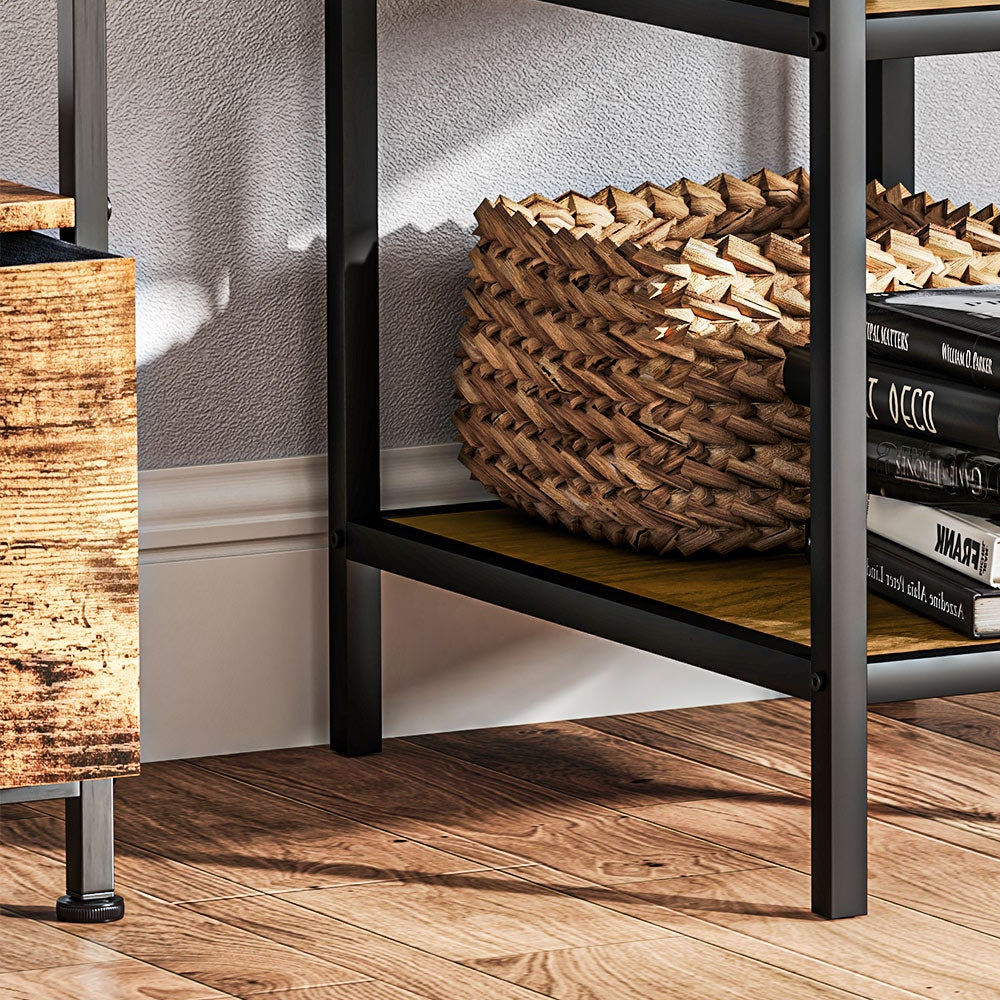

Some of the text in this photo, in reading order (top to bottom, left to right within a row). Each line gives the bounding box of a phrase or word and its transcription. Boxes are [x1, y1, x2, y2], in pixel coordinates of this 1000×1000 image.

[881, 325, 909, 352] MATTERS
[941, 342, 966, 367] WILLIAM
[965, 349, 973, 369] D.
[972, 351, 994, 376] PARKER
[866, 377, 879, 421] T
